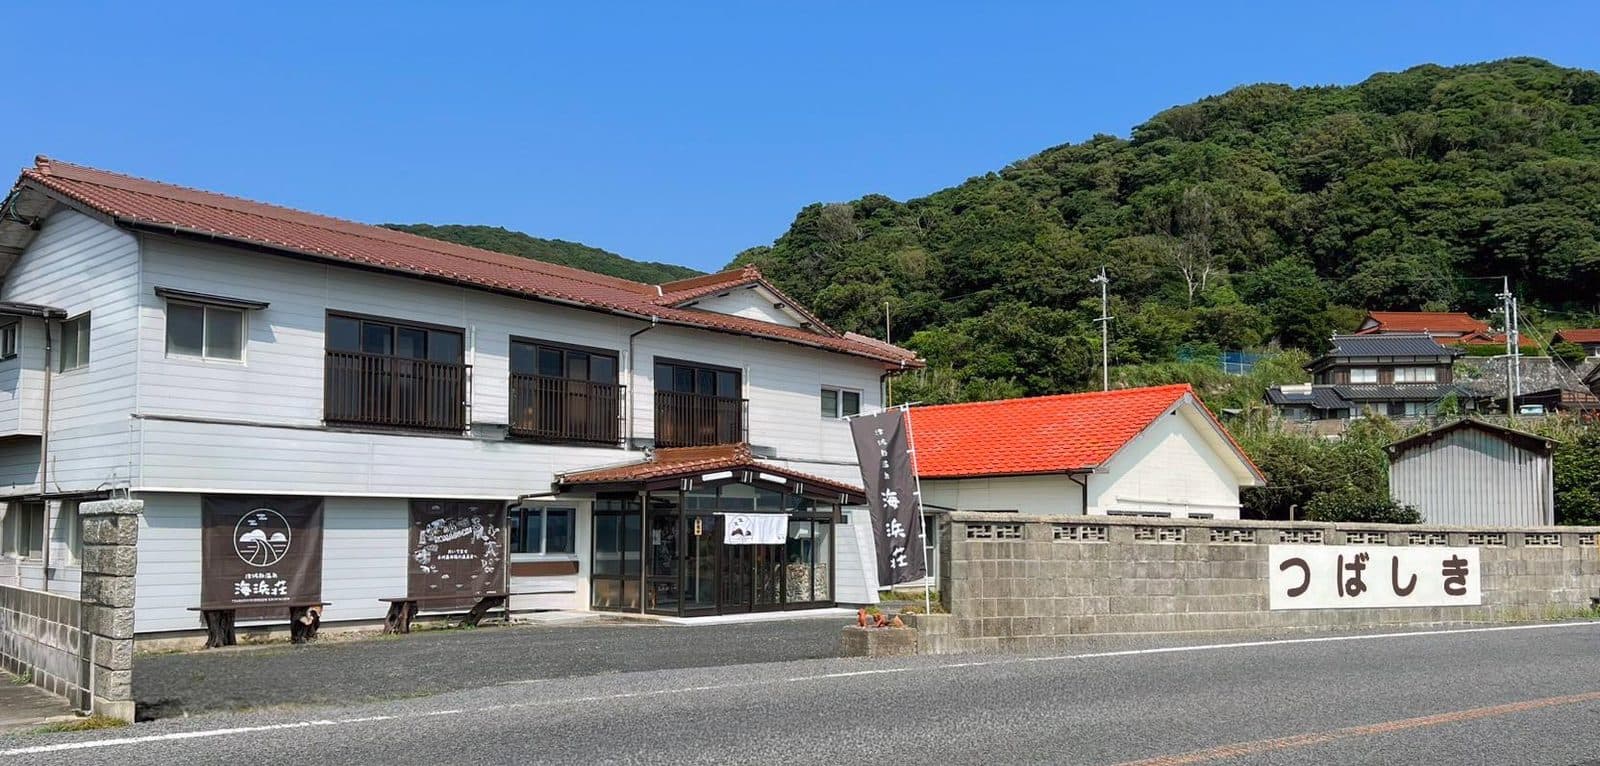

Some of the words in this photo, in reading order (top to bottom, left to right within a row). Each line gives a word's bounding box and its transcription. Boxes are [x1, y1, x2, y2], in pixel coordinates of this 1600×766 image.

[880, 488, 909, 569] 海浜荘
[234, 580, 288, 597] 海浜荘
[1279, 551, 1469, 598] つばしき
